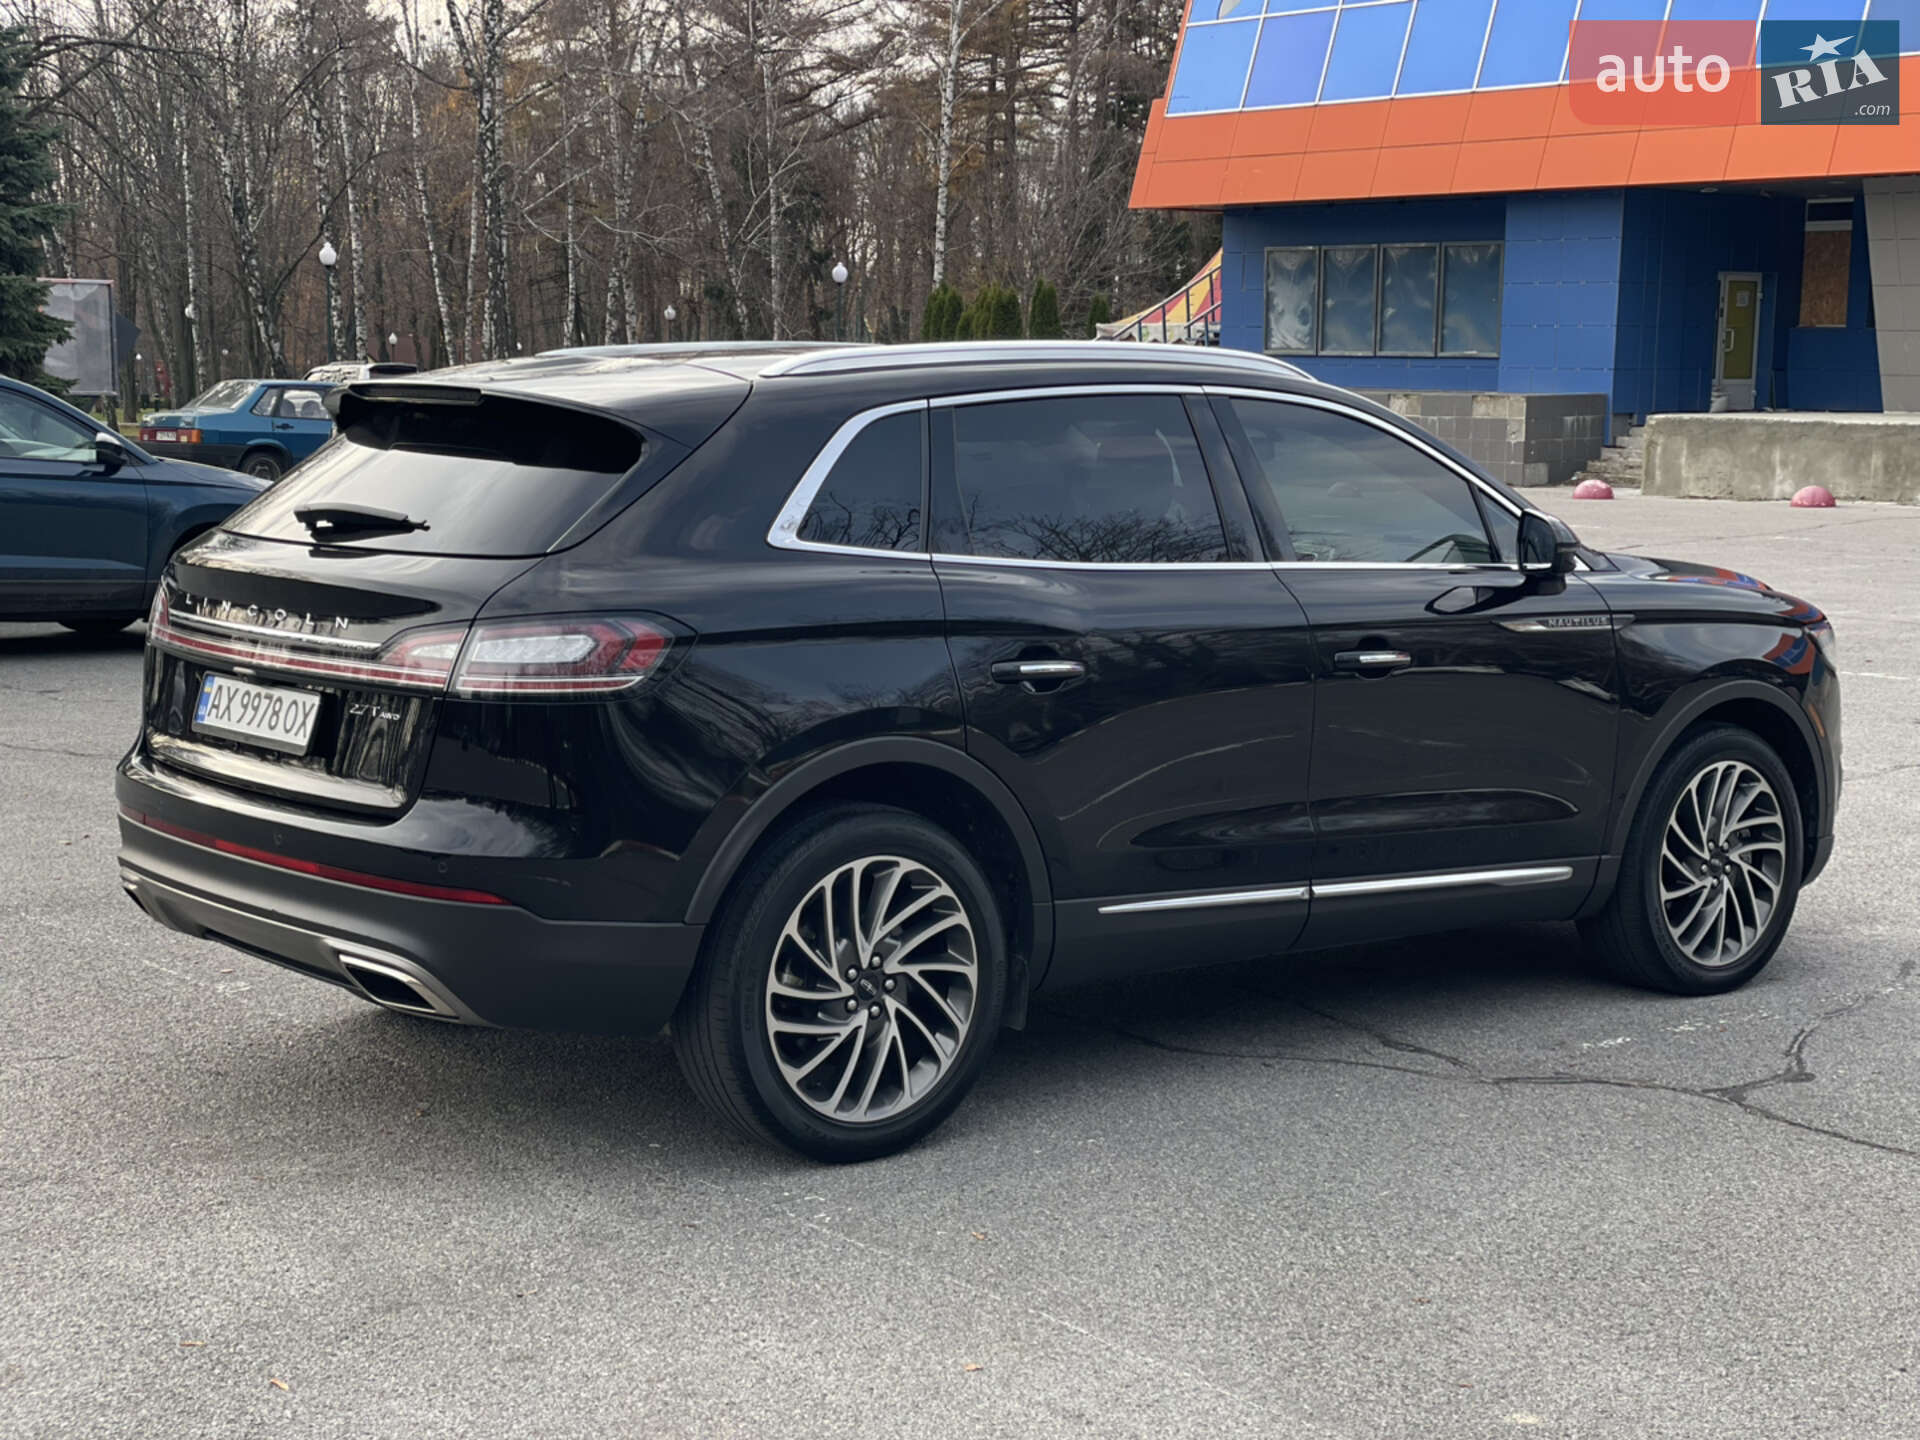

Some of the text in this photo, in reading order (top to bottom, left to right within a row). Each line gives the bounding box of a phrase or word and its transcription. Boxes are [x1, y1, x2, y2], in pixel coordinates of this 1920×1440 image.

[185, 593, 349, 629] LINCOLN
[1548, 616, 1607, 628] NAUTILUS
[207, 684, 317, 739] AX 9978 OX
